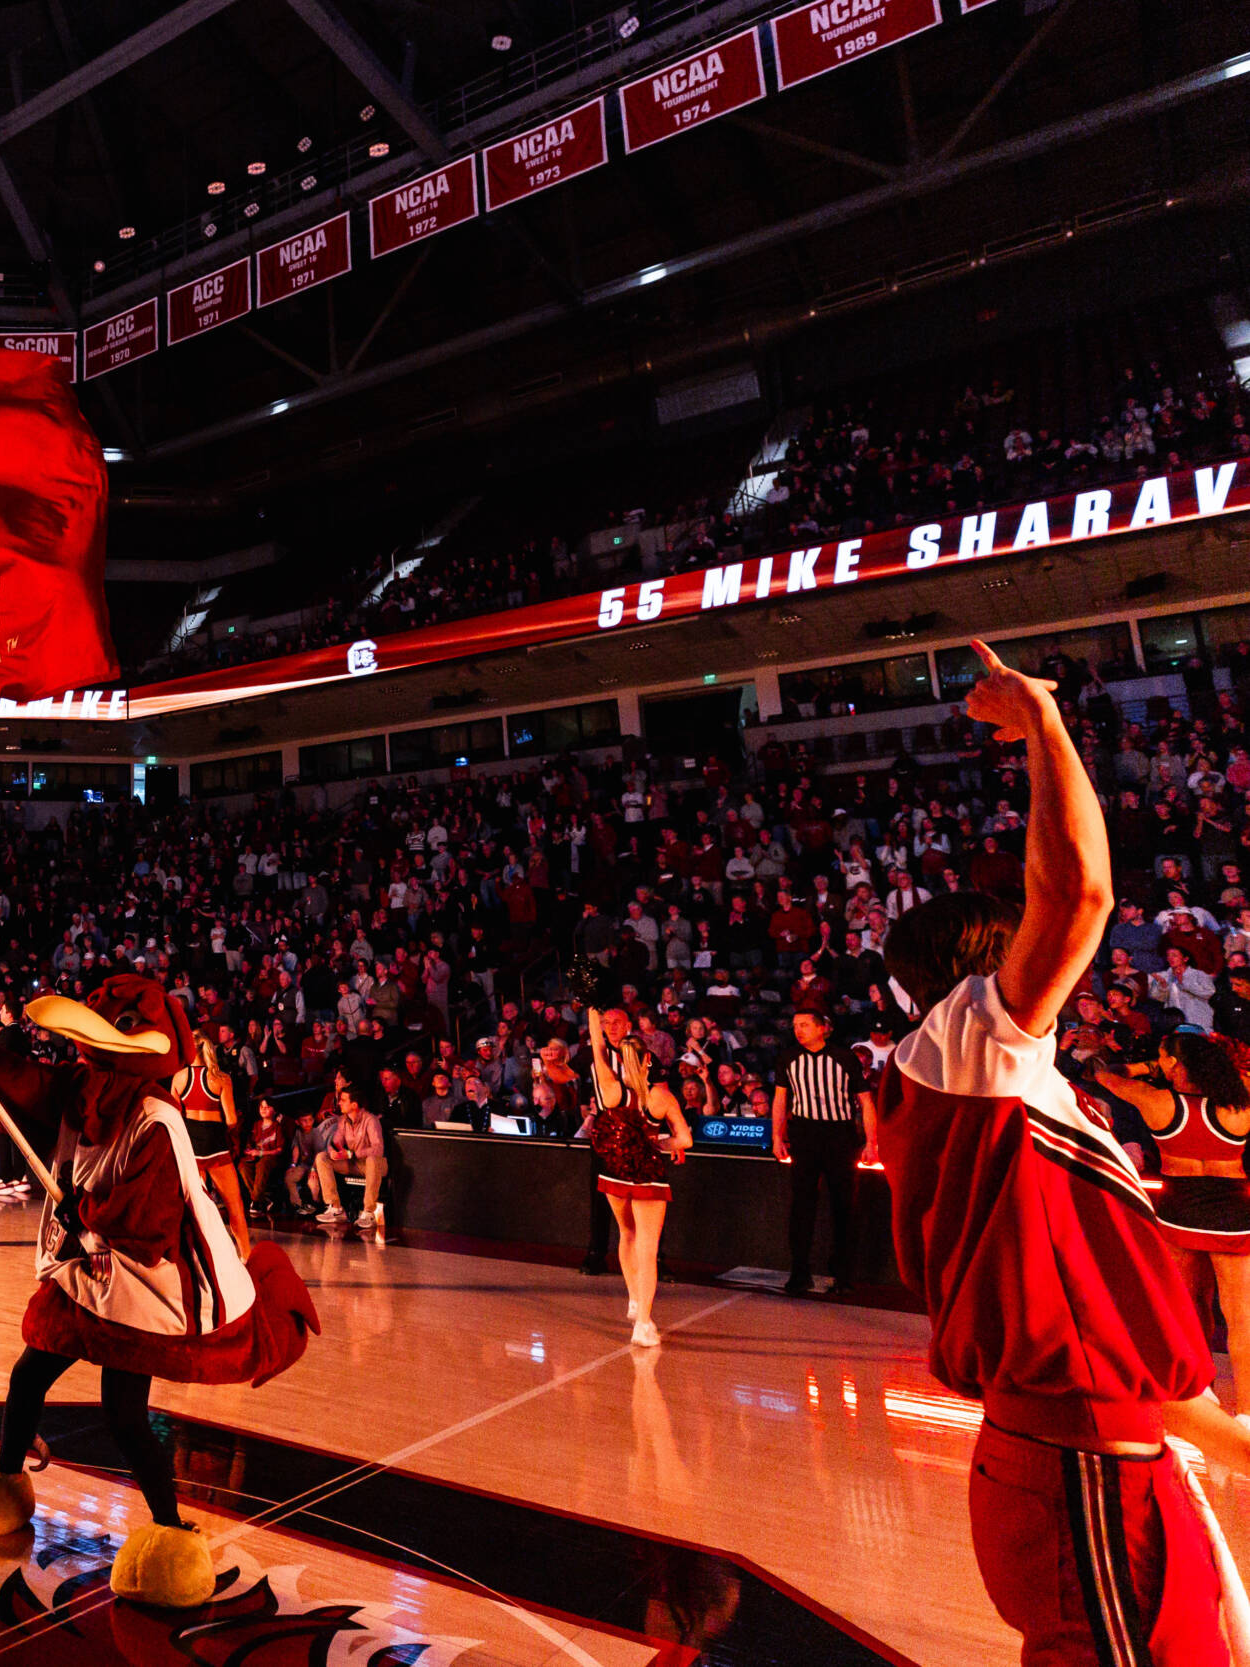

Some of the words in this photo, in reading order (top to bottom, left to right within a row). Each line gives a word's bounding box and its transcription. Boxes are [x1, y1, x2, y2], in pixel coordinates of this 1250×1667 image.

[810, 0, 890, 34] NCA
[820, 7, 886, 42] TOURNAMENT
[834, 31, 877, 59] 1989
[651, 52, 725, 103] NCAA
[661, 79, 719, 110] TOURNAMENT
[673, 100, 711, 127] 1974
[513, 119, 576, 164] NCAA
[525, 154, 549, 170] SWEET
[551, 148, 562, 160] 16
[528, 165, 561, 187] 1973
[395, 173, 450, 214] NCAA
[406, 206, 427, 220] SWEET
[409, 216, 437, 237] 1972
[279, 228, 327, 267] NCAA
[192, 274, 225, 305] ACC
[291, 269, 315, 288] 1971
[106, 313, 135, 343] ACC
[198, 310, 219, 328] 1971
[110, 348, 130, 364] 1970
[598, 580, 665, 628] 55
[700, 539, 862, 609] MIKE
[906, 462, 1238, 569] SHARAV
[707, 1122, 725, 1136] SEC
[731, 1124, 764, 1132] VIDEO
